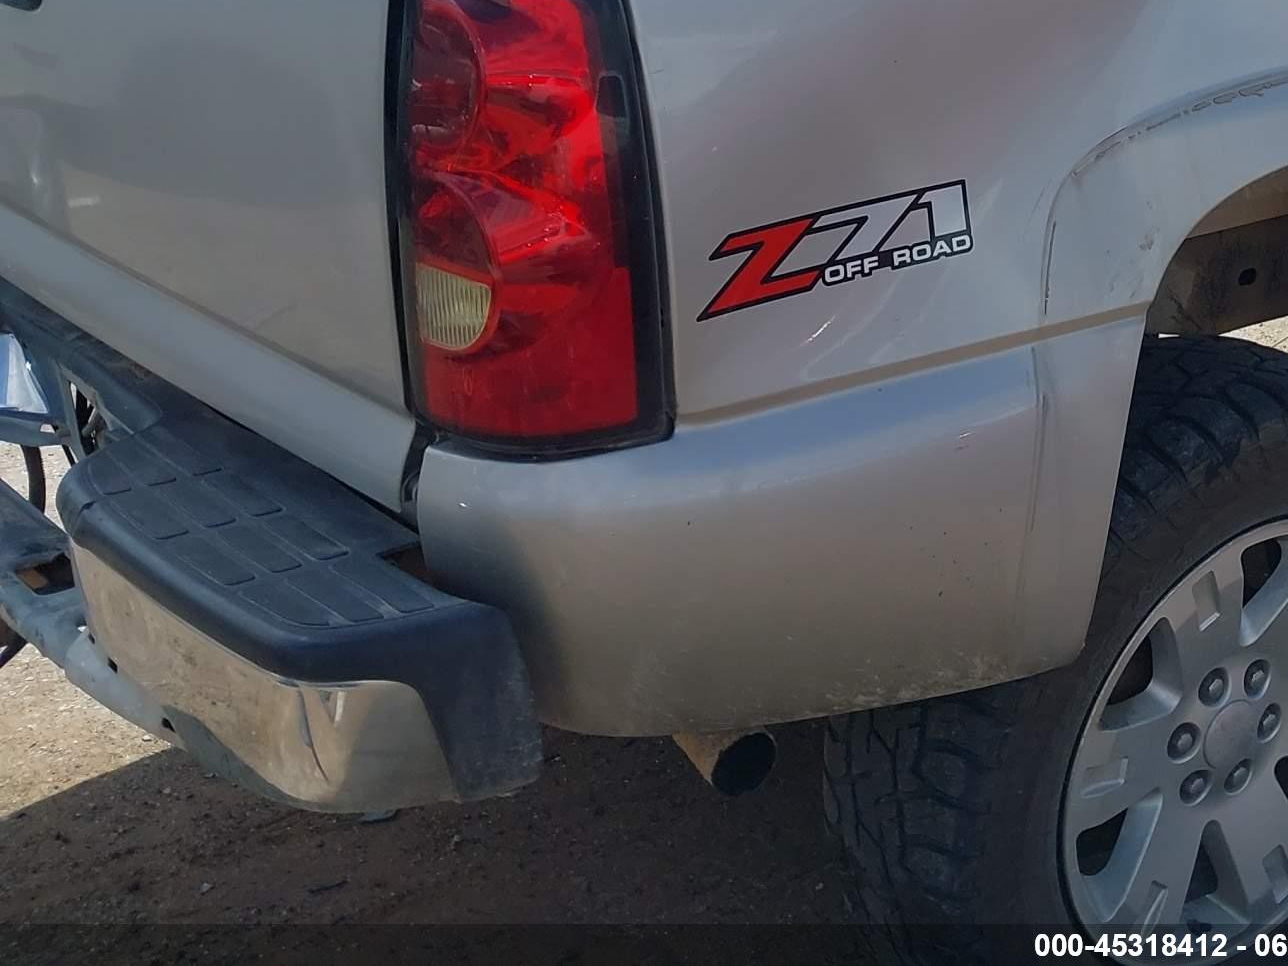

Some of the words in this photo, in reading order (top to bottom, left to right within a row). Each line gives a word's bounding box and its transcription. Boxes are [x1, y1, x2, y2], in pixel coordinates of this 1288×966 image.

[697, 179, 971, 322] Z71
[824, 255, 880, 284] OFF
[892, 233, 973, 267] ROAD
